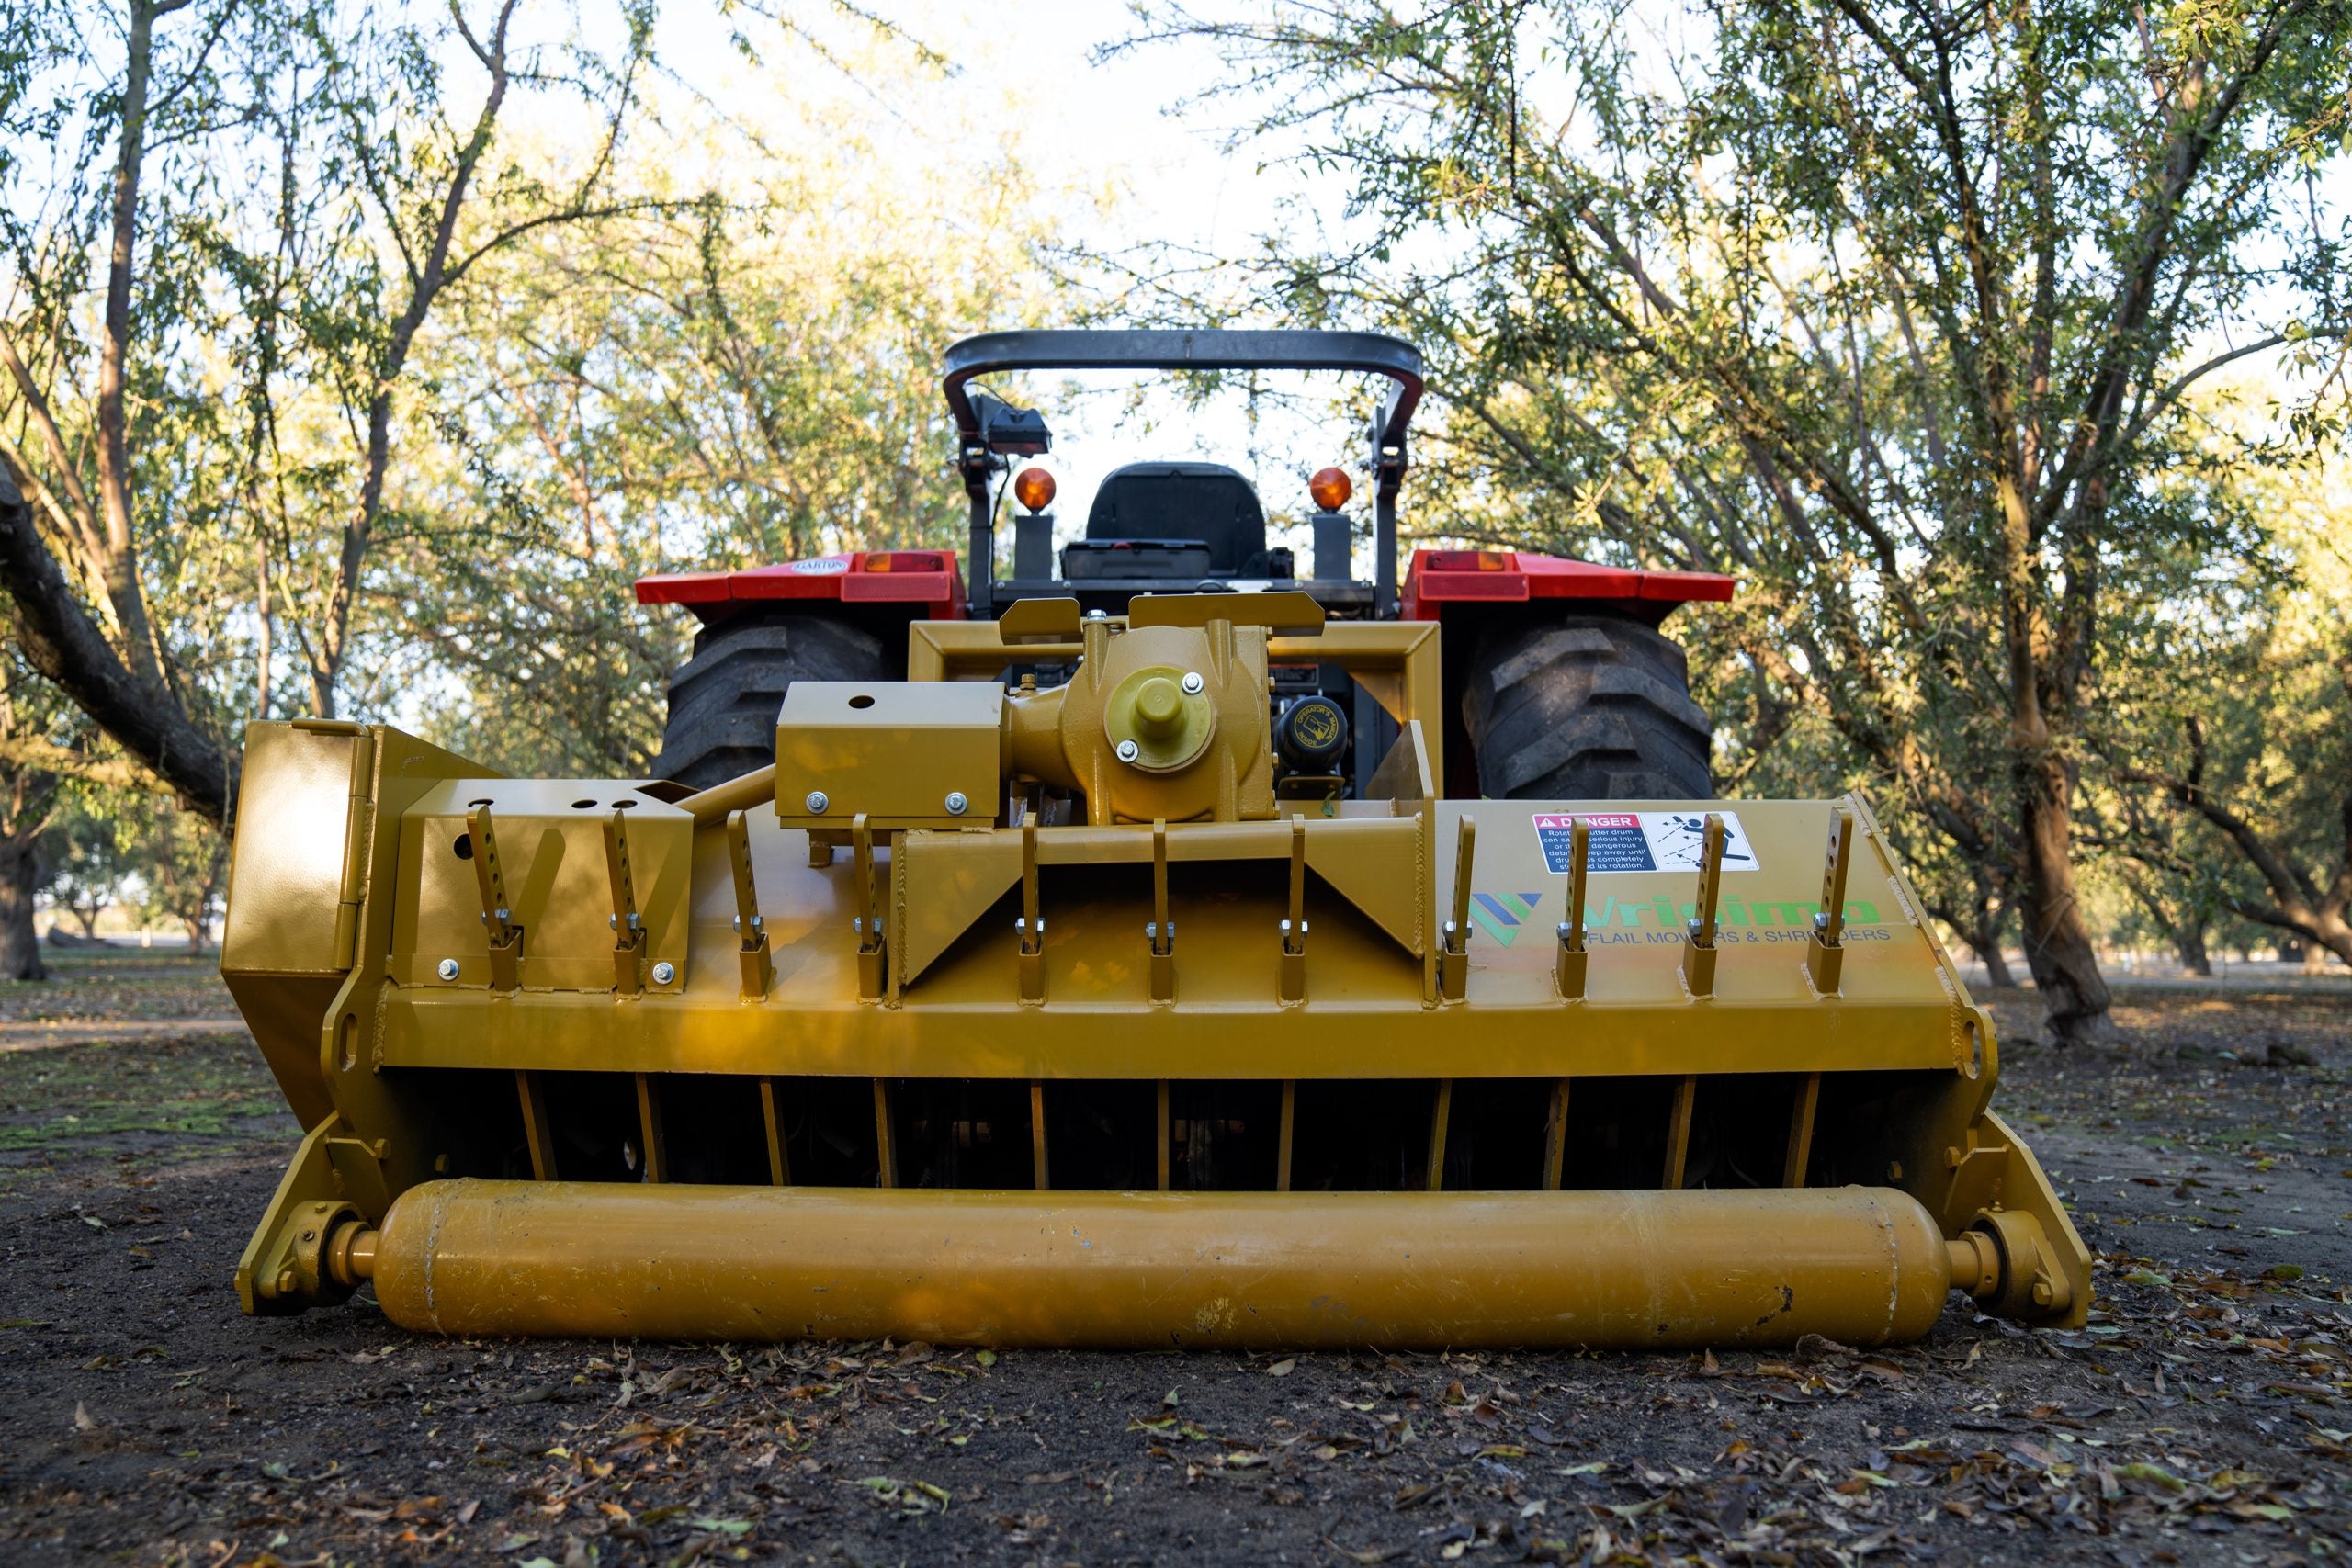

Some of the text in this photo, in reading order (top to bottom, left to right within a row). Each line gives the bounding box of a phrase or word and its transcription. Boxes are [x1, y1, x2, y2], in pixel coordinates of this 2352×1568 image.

[1560, 817, 1632, 827] DNGER
[1588, 929, 1891, 944] FLAIL MORS & SHRDERS
